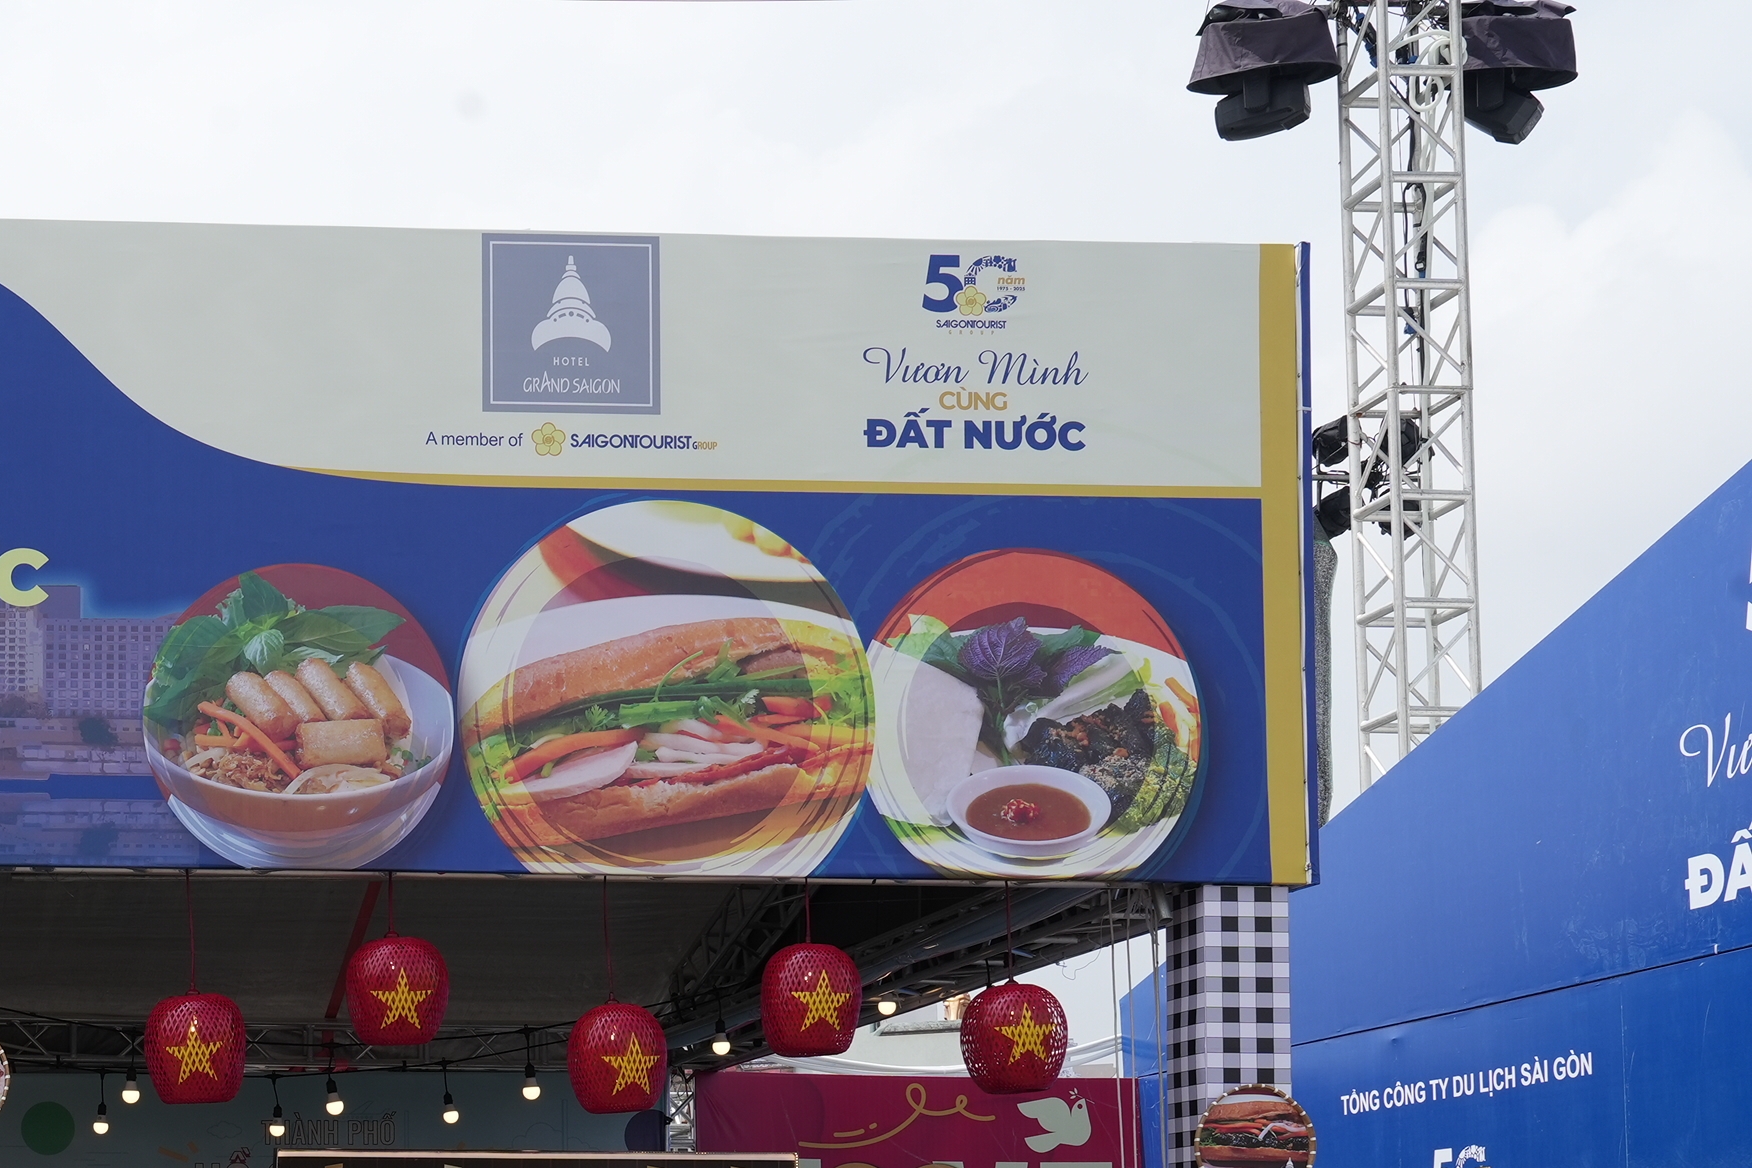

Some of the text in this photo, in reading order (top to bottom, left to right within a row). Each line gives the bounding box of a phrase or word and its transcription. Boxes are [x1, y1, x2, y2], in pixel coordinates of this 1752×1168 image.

[997, 275, 1026, 285] năm
[935, 319, 1007, 330] SAIGONTOURIST
[552, 356, 590, 367] HOTEL
[862, 347, 1089, 386] Vươn Mình
[522, 370, 620, 394] GRAND SAIGON
[939, 386, 1008, 411] CÙNG
[425, 431, 693, 450] A member of SAIGONTOURIST
[863, 408, 1086, 451] ĐẤT NƯỚC
[1341, 1048, 1593, 1116] TỔNG CÔNG TY DU LỊCH SÀI GÒN
[348, 1111, 397, 1146] PHỐ
